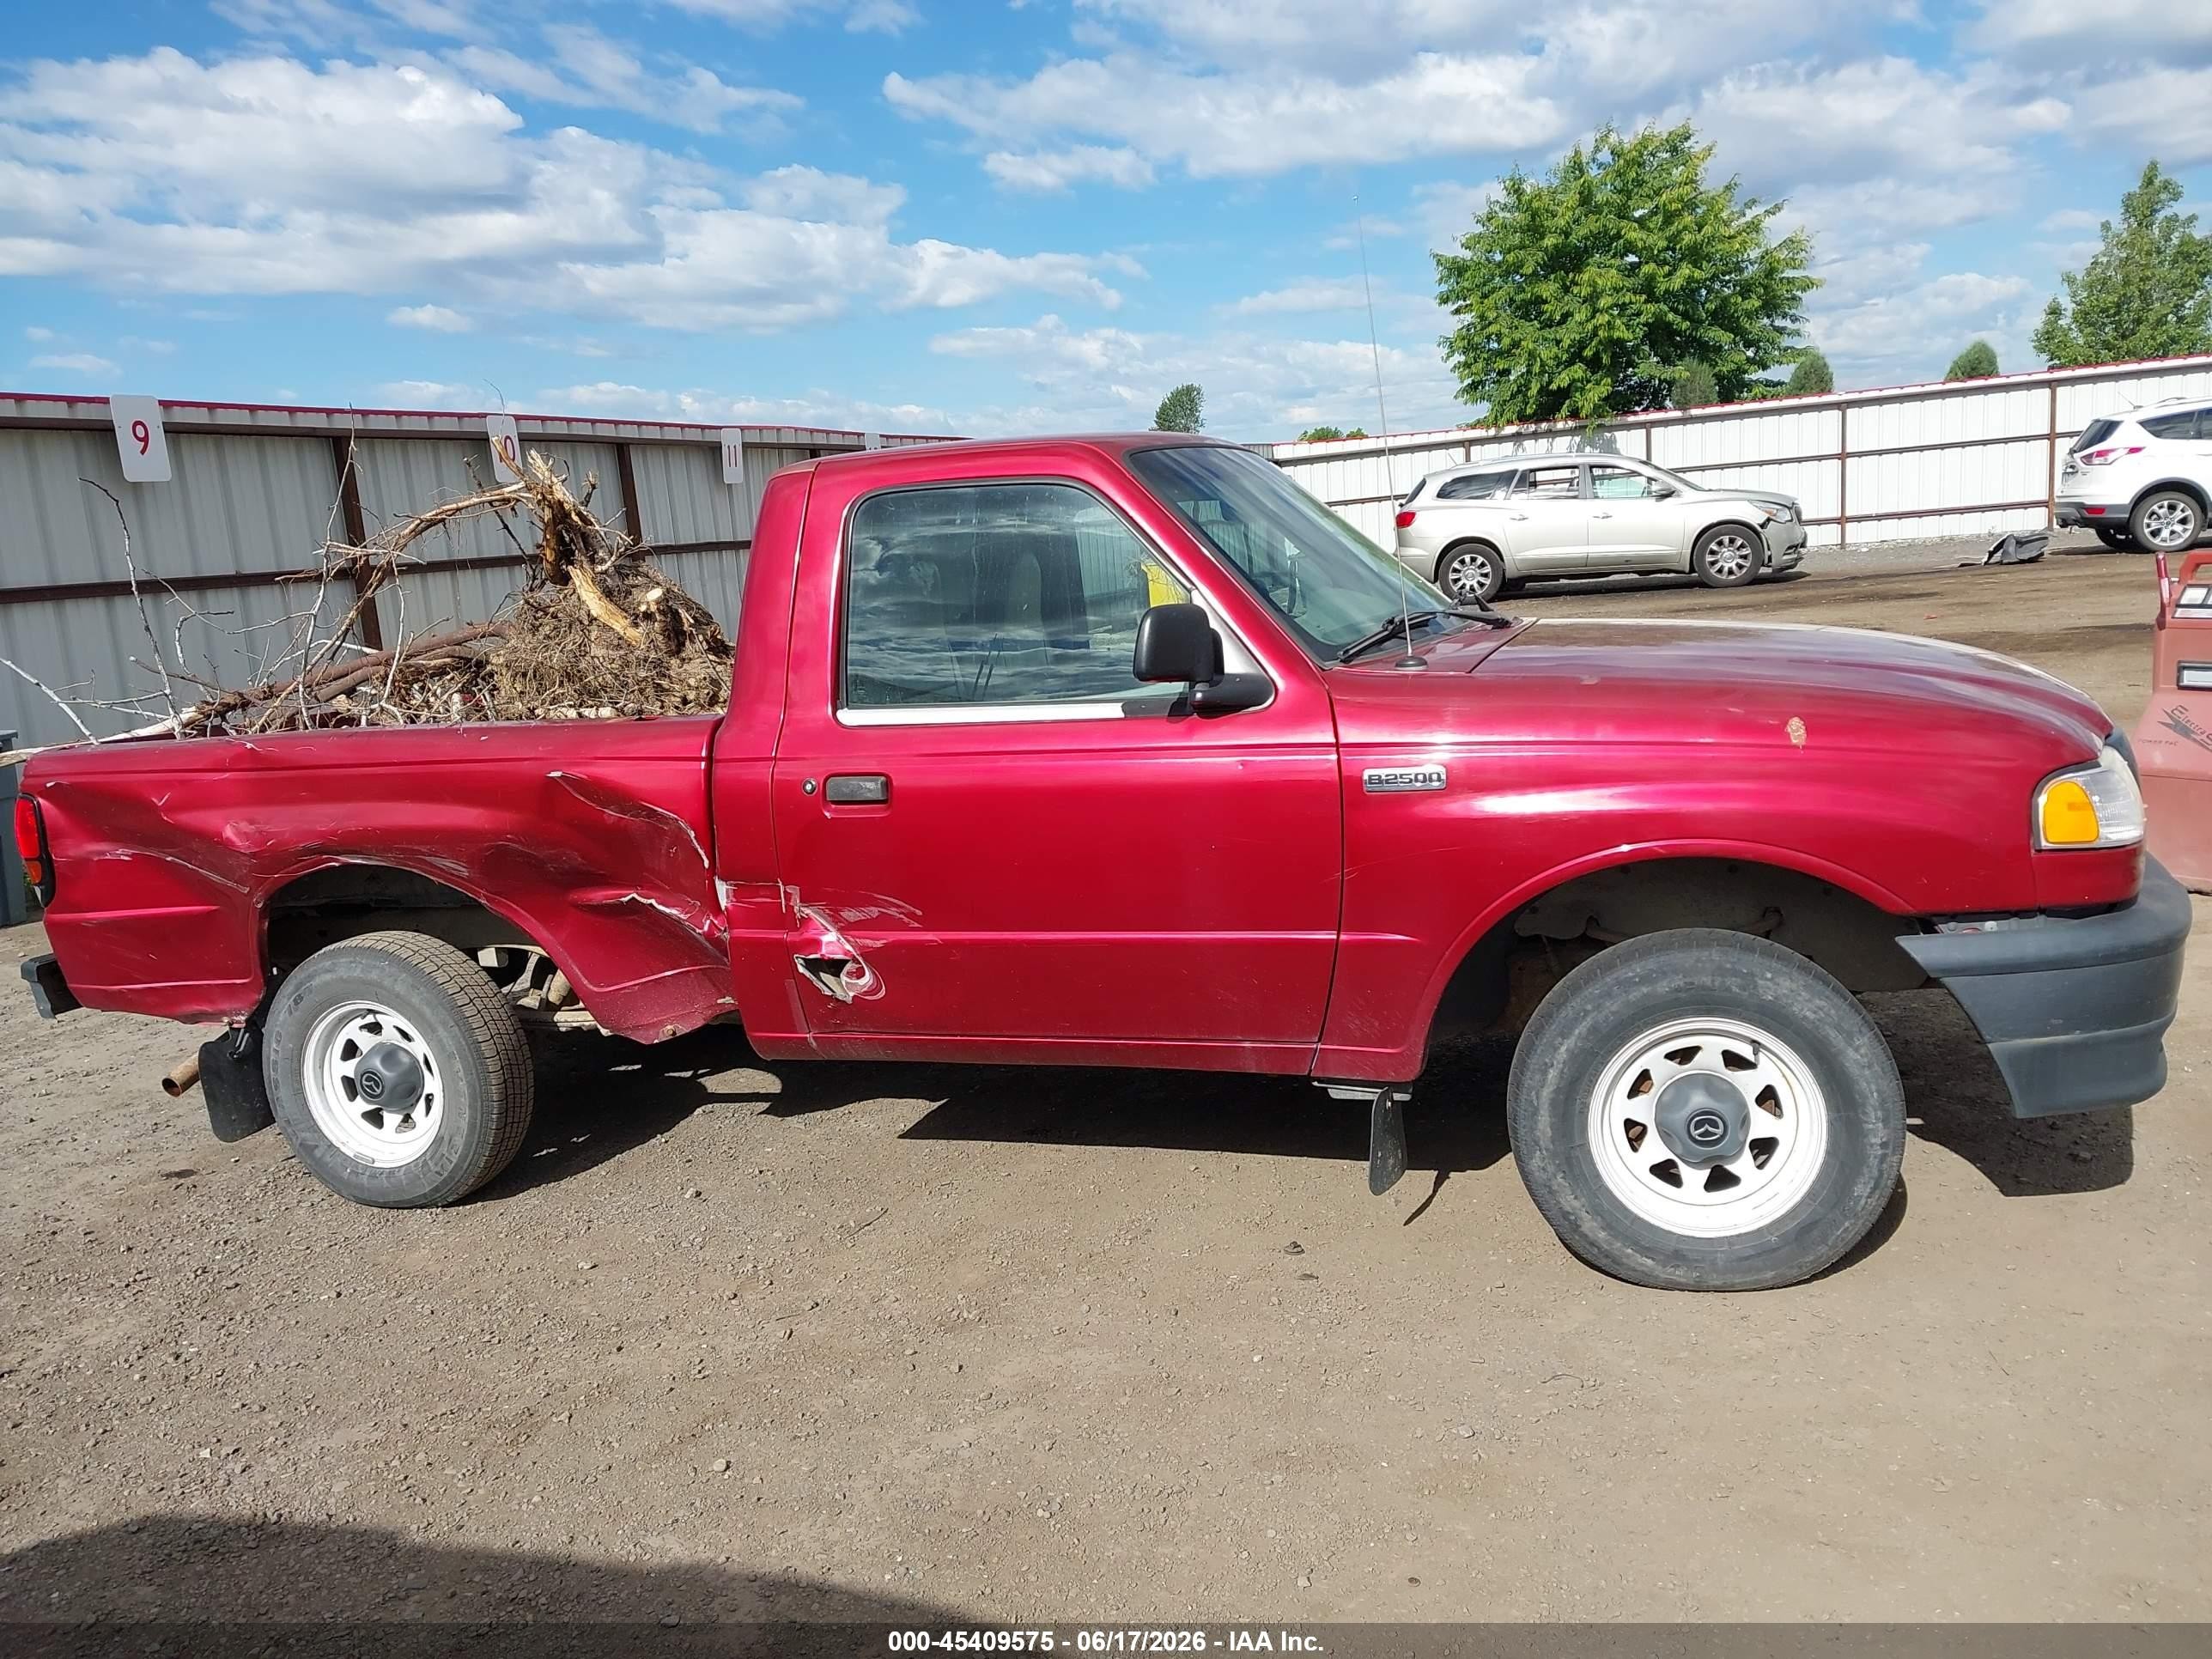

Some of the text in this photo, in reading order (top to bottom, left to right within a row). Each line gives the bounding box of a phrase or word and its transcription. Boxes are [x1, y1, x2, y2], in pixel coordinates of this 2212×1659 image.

[131, 420, 149, 456] 9
[727, 444, 738, 468] 11
[1367, 772, 1442, 786] B2500
